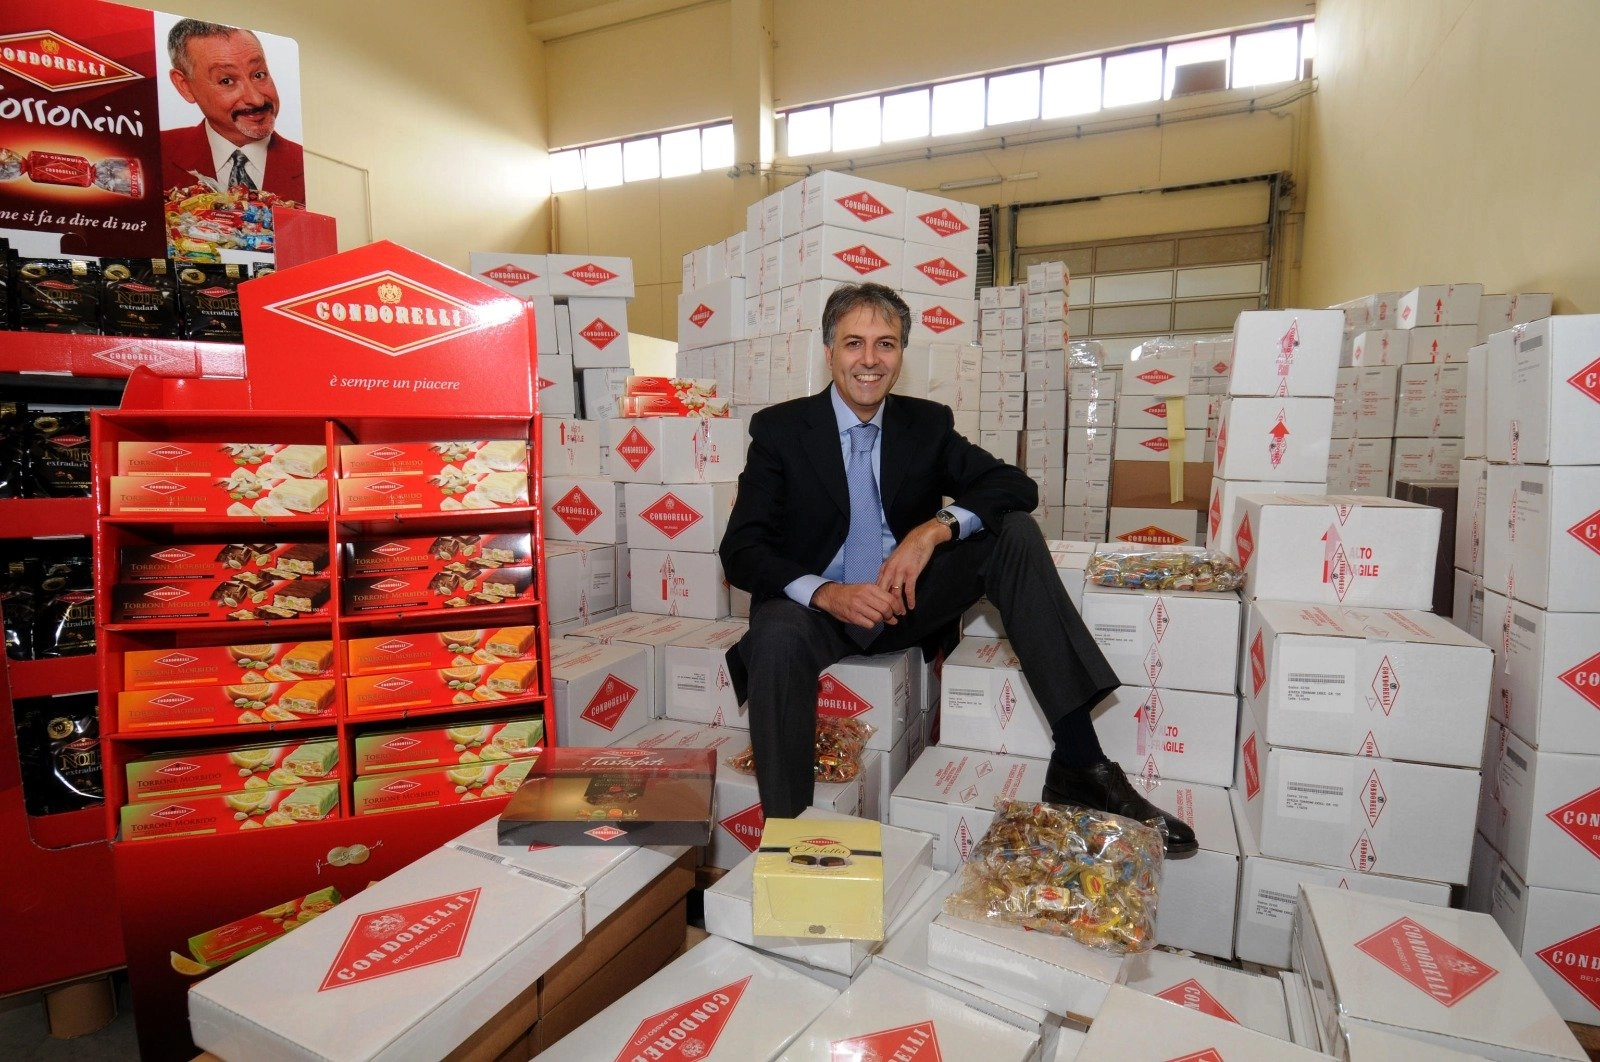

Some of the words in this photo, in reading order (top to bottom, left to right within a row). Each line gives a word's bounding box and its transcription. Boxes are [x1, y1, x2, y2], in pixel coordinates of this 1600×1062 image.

[0, 46, 106, 77] ONDORELLI
[0, 84, 144, 138] orroncini
[844, 199, 884, 215] CONDORELLI
[22, 211, 35, 222] si
[34, 210, 53, 226] fa
[56, 216, 66, 225] a
[69, 213, 100, 227] dire
[102, 216, 118, 229] di
[121, 220, 147, 232] no?
[925, 217, 961, 231] CONDORELLI
[842, 252, 882, 267] CONDORELLI
[489, 271, 530, 280] CONDORELLI
[571, 271, 610, 280] CONDORELLI
[923, 265, 959, 279] CONDORELLI
[201, 309, 239, 317] extradark
[315, 301, 462, 327] CONDORELLI
[340, 377, 390, 391] sempre
[393, 378, 411, 389] un
[413, 376, 461, 393] piacere
[46, 460, 89, 468] extradark
[556, 505, 597, 516] CONDORELLI
[649, 512, 693, 522] CONDORELLI
[1127, 534, 1175, 544] CONDORELLI
[591, 691, 630, 717] CONDORELLI
[818, 697, 857, 711] DORELLI
[363, 795, 400, 805] TORRONE
[402, 789, 440, 799] MORBIDO
[131, 822, 173, 831] TORRONE
[176, 816, 217, 826] MORBIDO
[336, 895, 472, 982] CONDORELLI
[392, 933, 438, 964] BELPASSO
[1402, 924, 1453, 998] CONDORELLI
